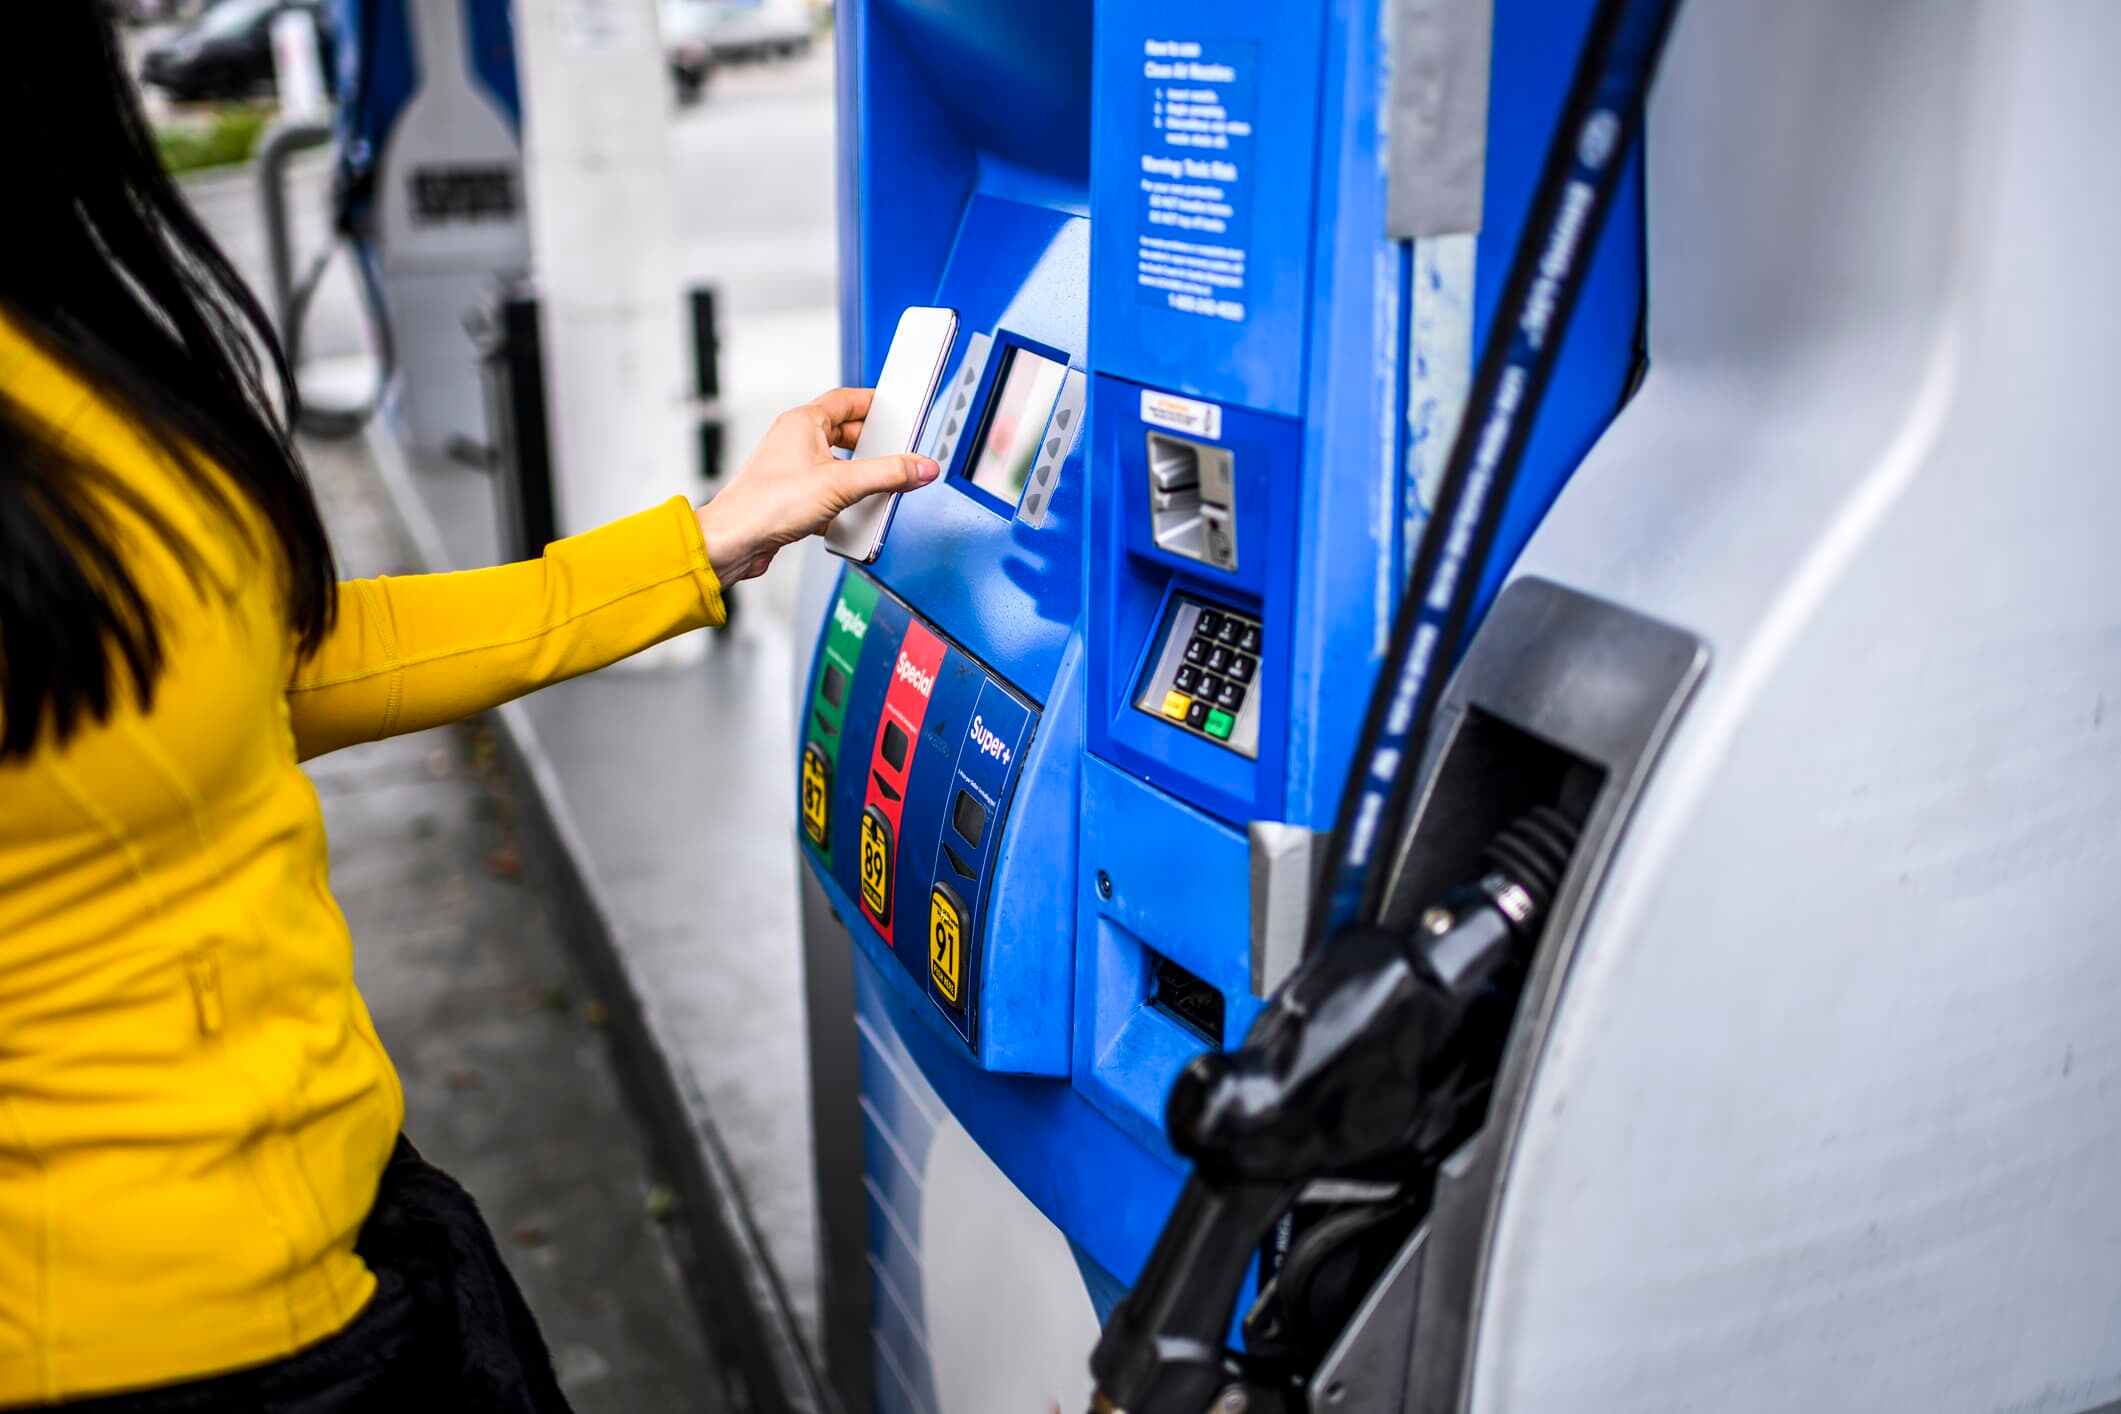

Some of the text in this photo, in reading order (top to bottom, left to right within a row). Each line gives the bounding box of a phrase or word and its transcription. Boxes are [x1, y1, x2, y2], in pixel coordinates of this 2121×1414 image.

[896, 651, 935, 698] Special
[970, 715, 1011, 765] Super+
[805, 777, 822, 818] 87
[865, 841, 883, 888] 89
[935, 921, 954, 977] 91
